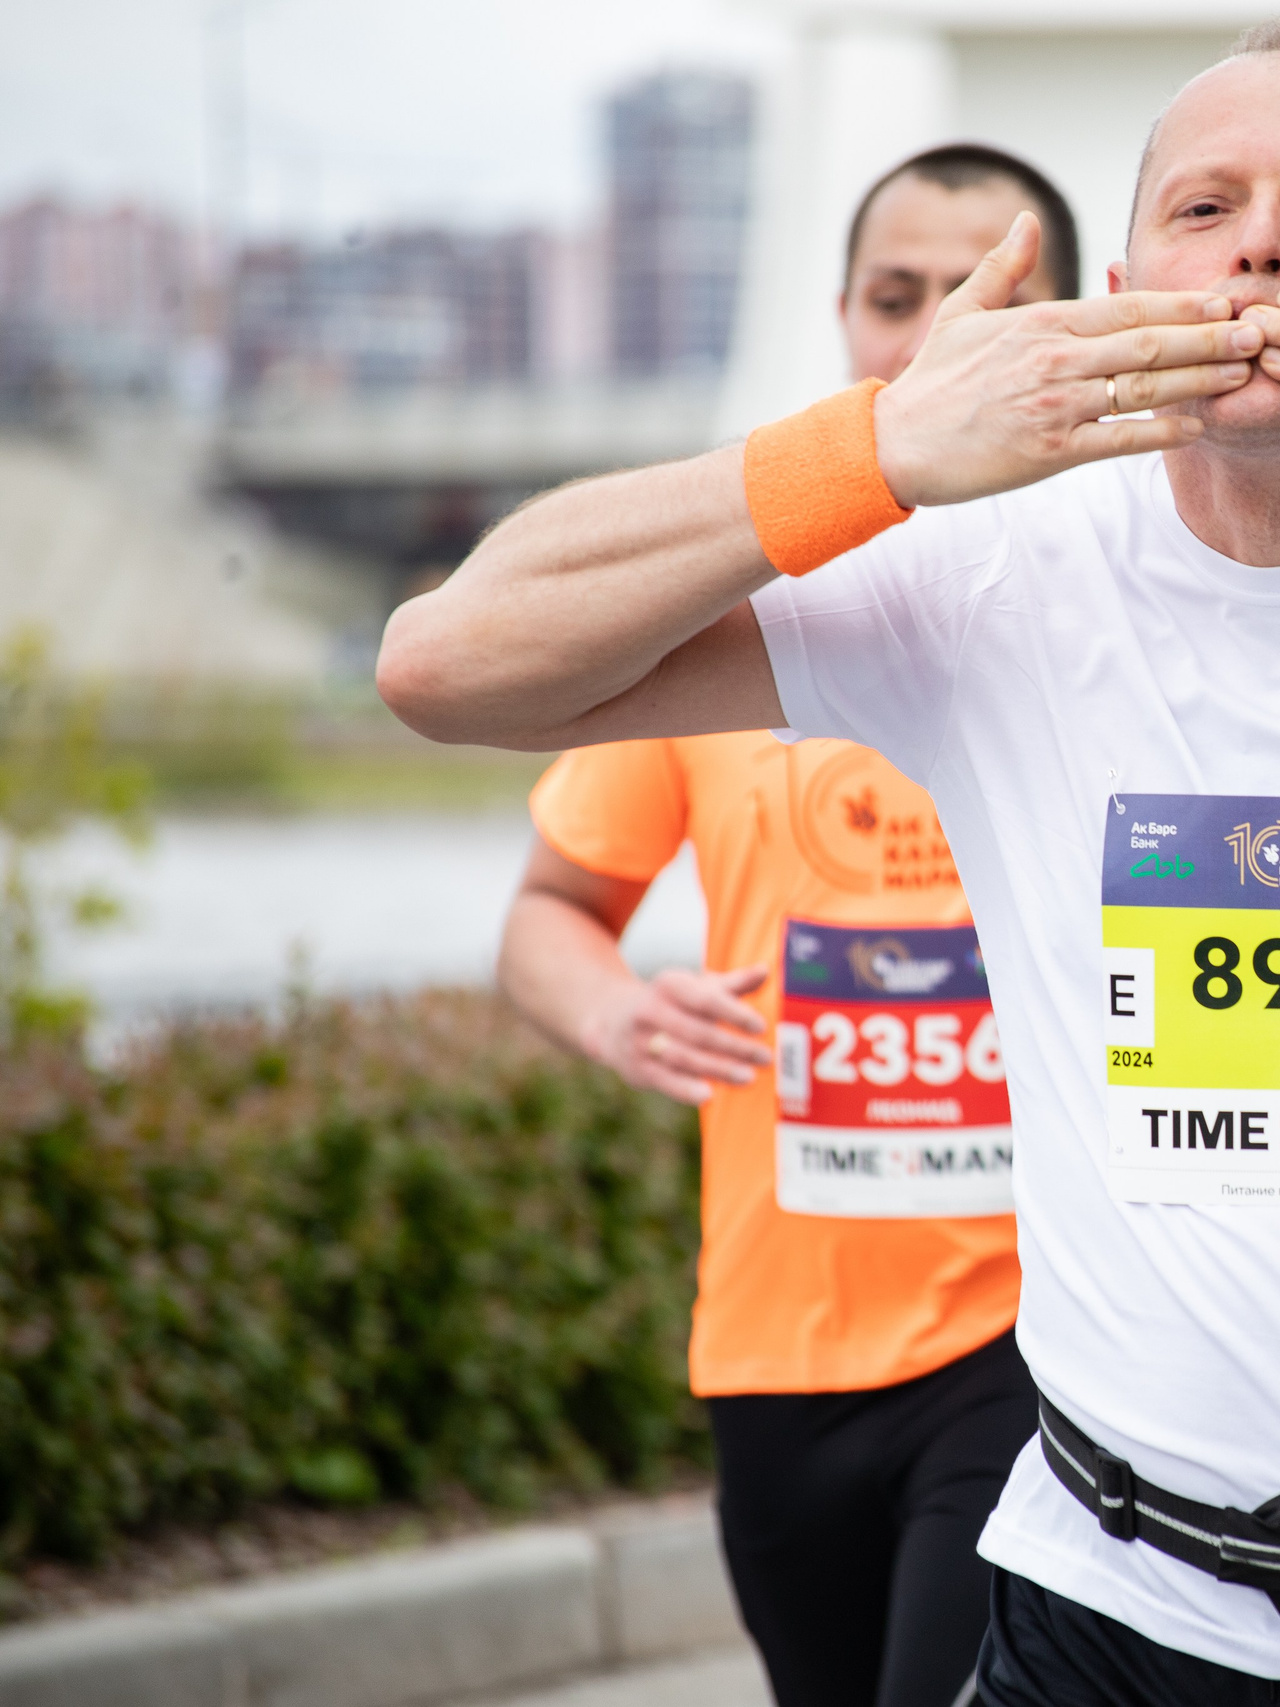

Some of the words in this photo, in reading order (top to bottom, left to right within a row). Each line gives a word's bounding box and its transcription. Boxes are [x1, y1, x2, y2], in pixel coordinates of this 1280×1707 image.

[1131, 822, 1147, 834] Ак
[1148, 822, 1178, 837] Барс
[1130, 836, 1159, 849] Банк
[1110, 974, 1135, 1017] E
[812, 1011, 1006, 1087] 2356
[1112, 1050, 1153, 1068] 2024
[1221, 1184, 1275, 1196] Питание
